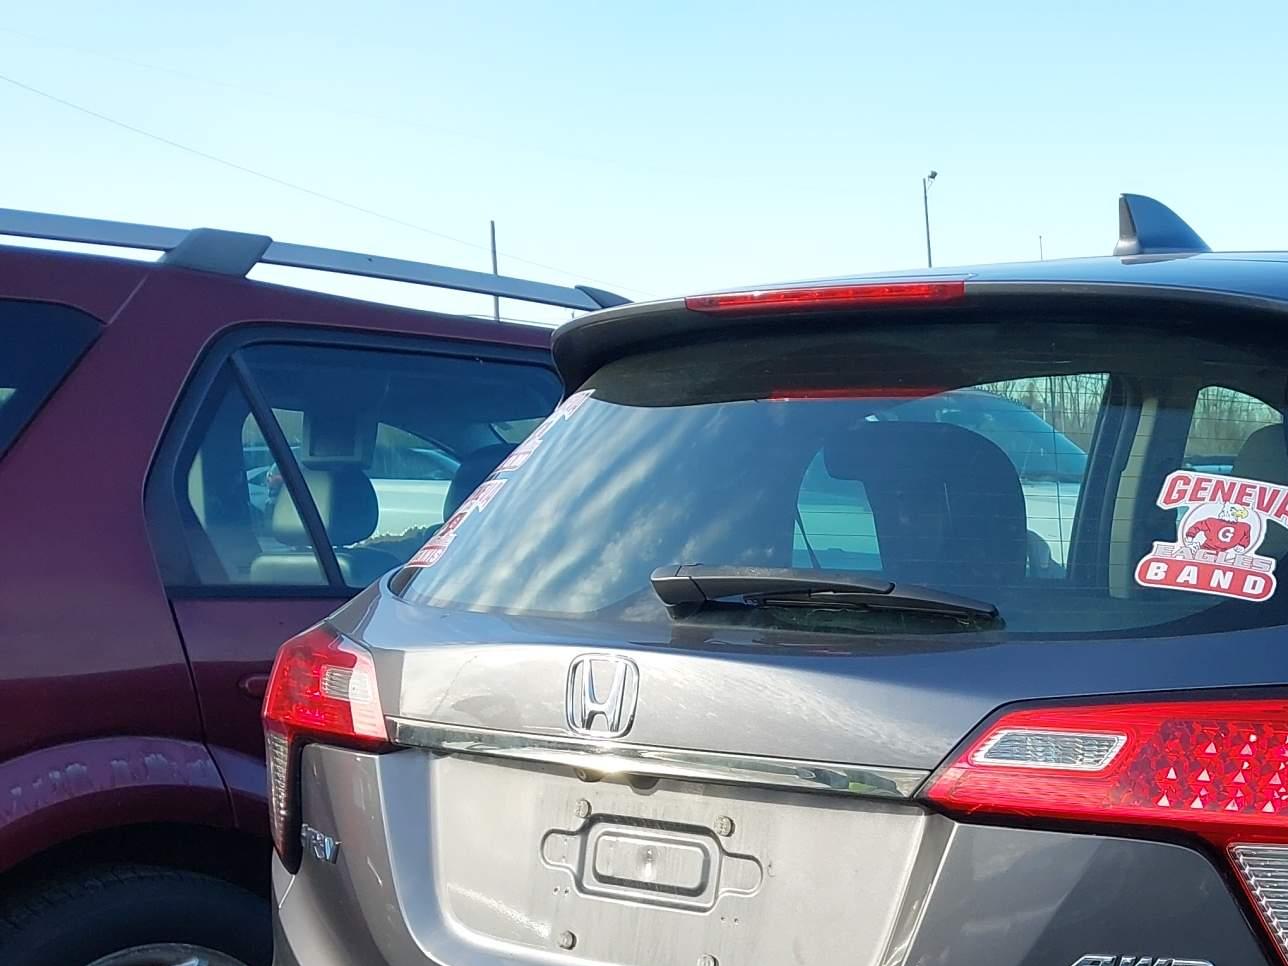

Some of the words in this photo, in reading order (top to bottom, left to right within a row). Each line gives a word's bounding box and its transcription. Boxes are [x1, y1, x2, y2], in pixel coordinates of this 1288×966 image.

[1217, 526, 1235, 543] G
[1151, 542, 1274, 573] EAGLES
[1145, 561, 1267, 596] BAND
